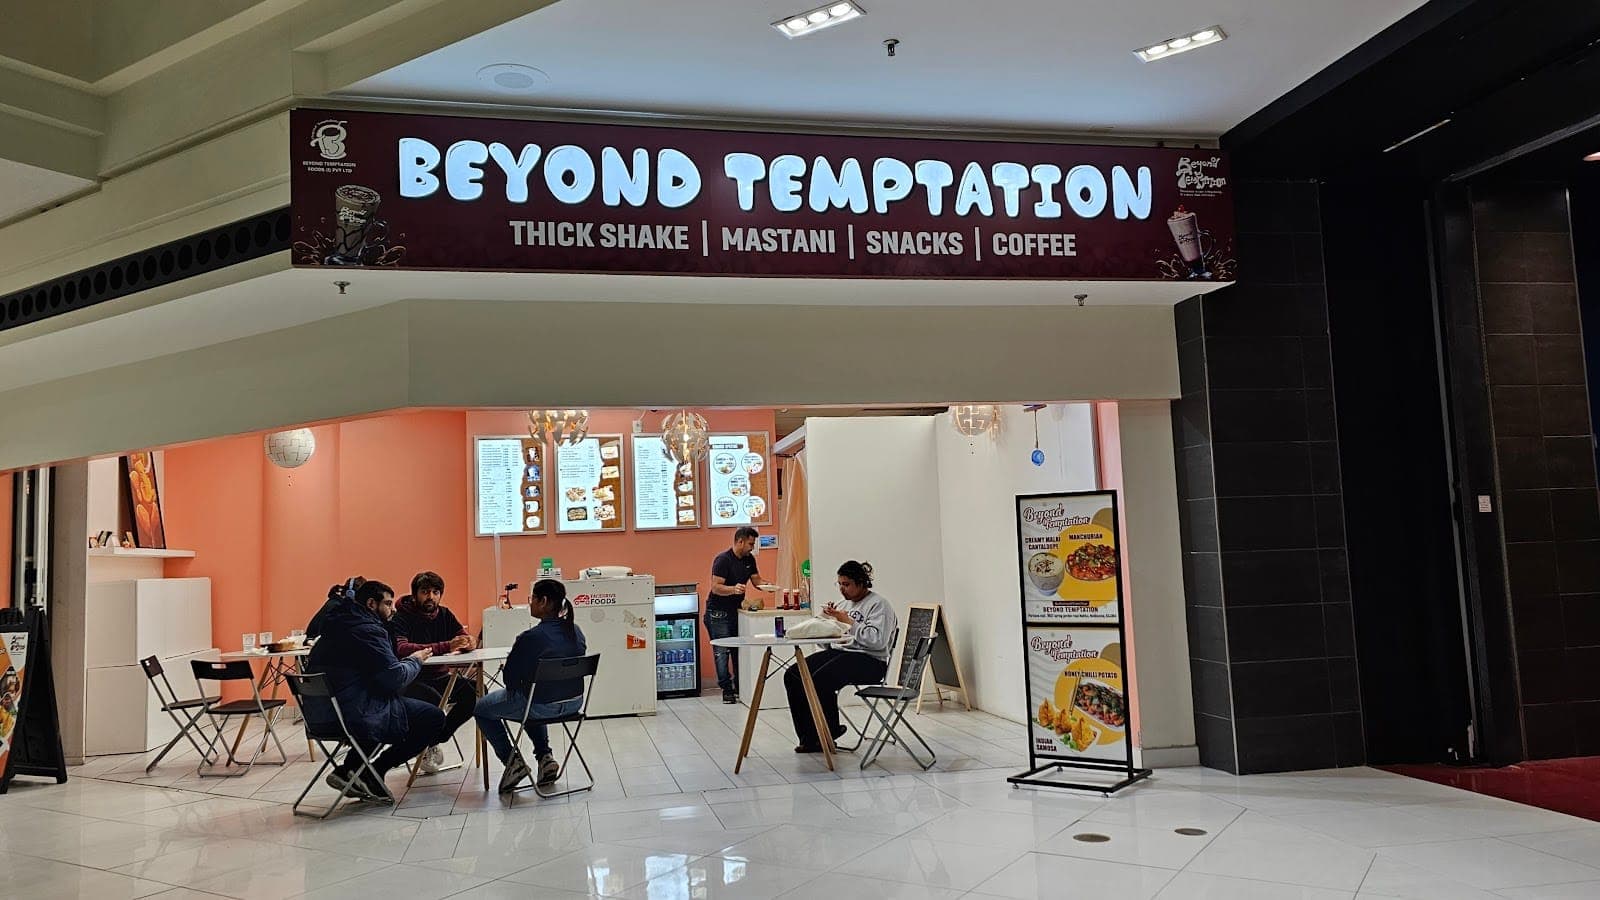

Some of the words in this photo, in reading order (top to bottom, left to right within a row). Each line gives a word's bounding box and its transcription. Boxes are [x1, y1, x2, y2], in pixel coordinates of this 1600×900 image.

[399, 137, 701, 208] BEYOND
[724, 152, 1152, 220] TEMPTATION
[509, 220, 595, 247] THICK
[600, 222, 689, 250] SHAKE
[722, 227, 835, 254] MASTANI
[866, 230, 963, 256] SNACKS
[992, 233, 1076, 257] COFFEE
[1024, 503, 1064, 524] Beyond
[1040, 515, 1091, 531] Temptation
[1031, 635, 1072, 655] Beyond
[1050, 650, 1098, 663] Temptation
[1036, 744, 1058, 752] SAMOSA
